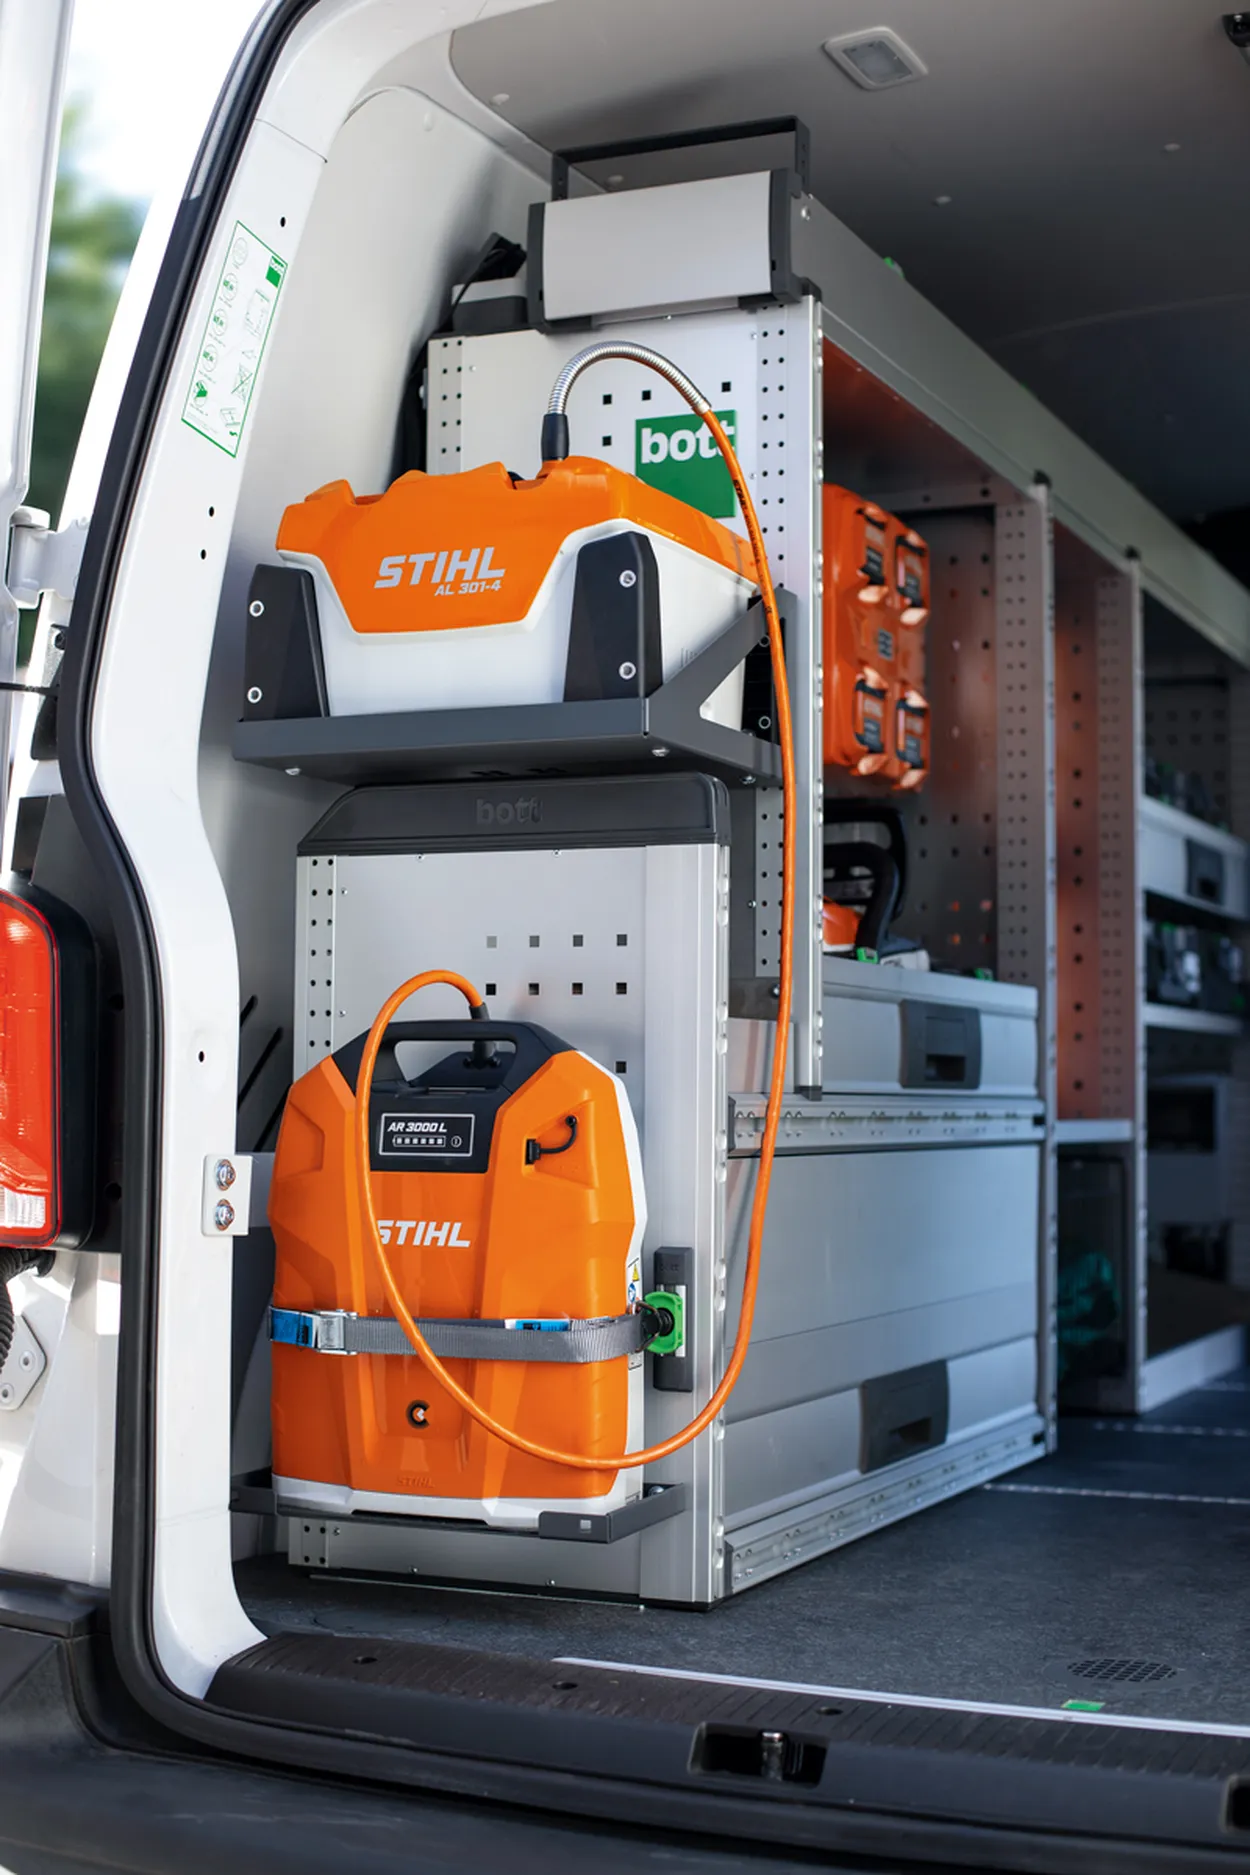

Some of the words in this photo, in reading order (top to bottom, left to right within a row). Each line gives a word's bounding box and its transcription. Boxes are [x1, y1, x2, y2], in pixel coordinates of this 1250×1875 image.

[374, 546, 506, 589] STIHL
[434, 584, 455, 596] AL
[458, 580, 502, 594] 301-4
[387, 1122, 405, 1132] AR
[405, 1122, 439, 1132] 3000
[438, 1122, 448, 1132] L
[377, 1219, 471, 1248] STIHL
